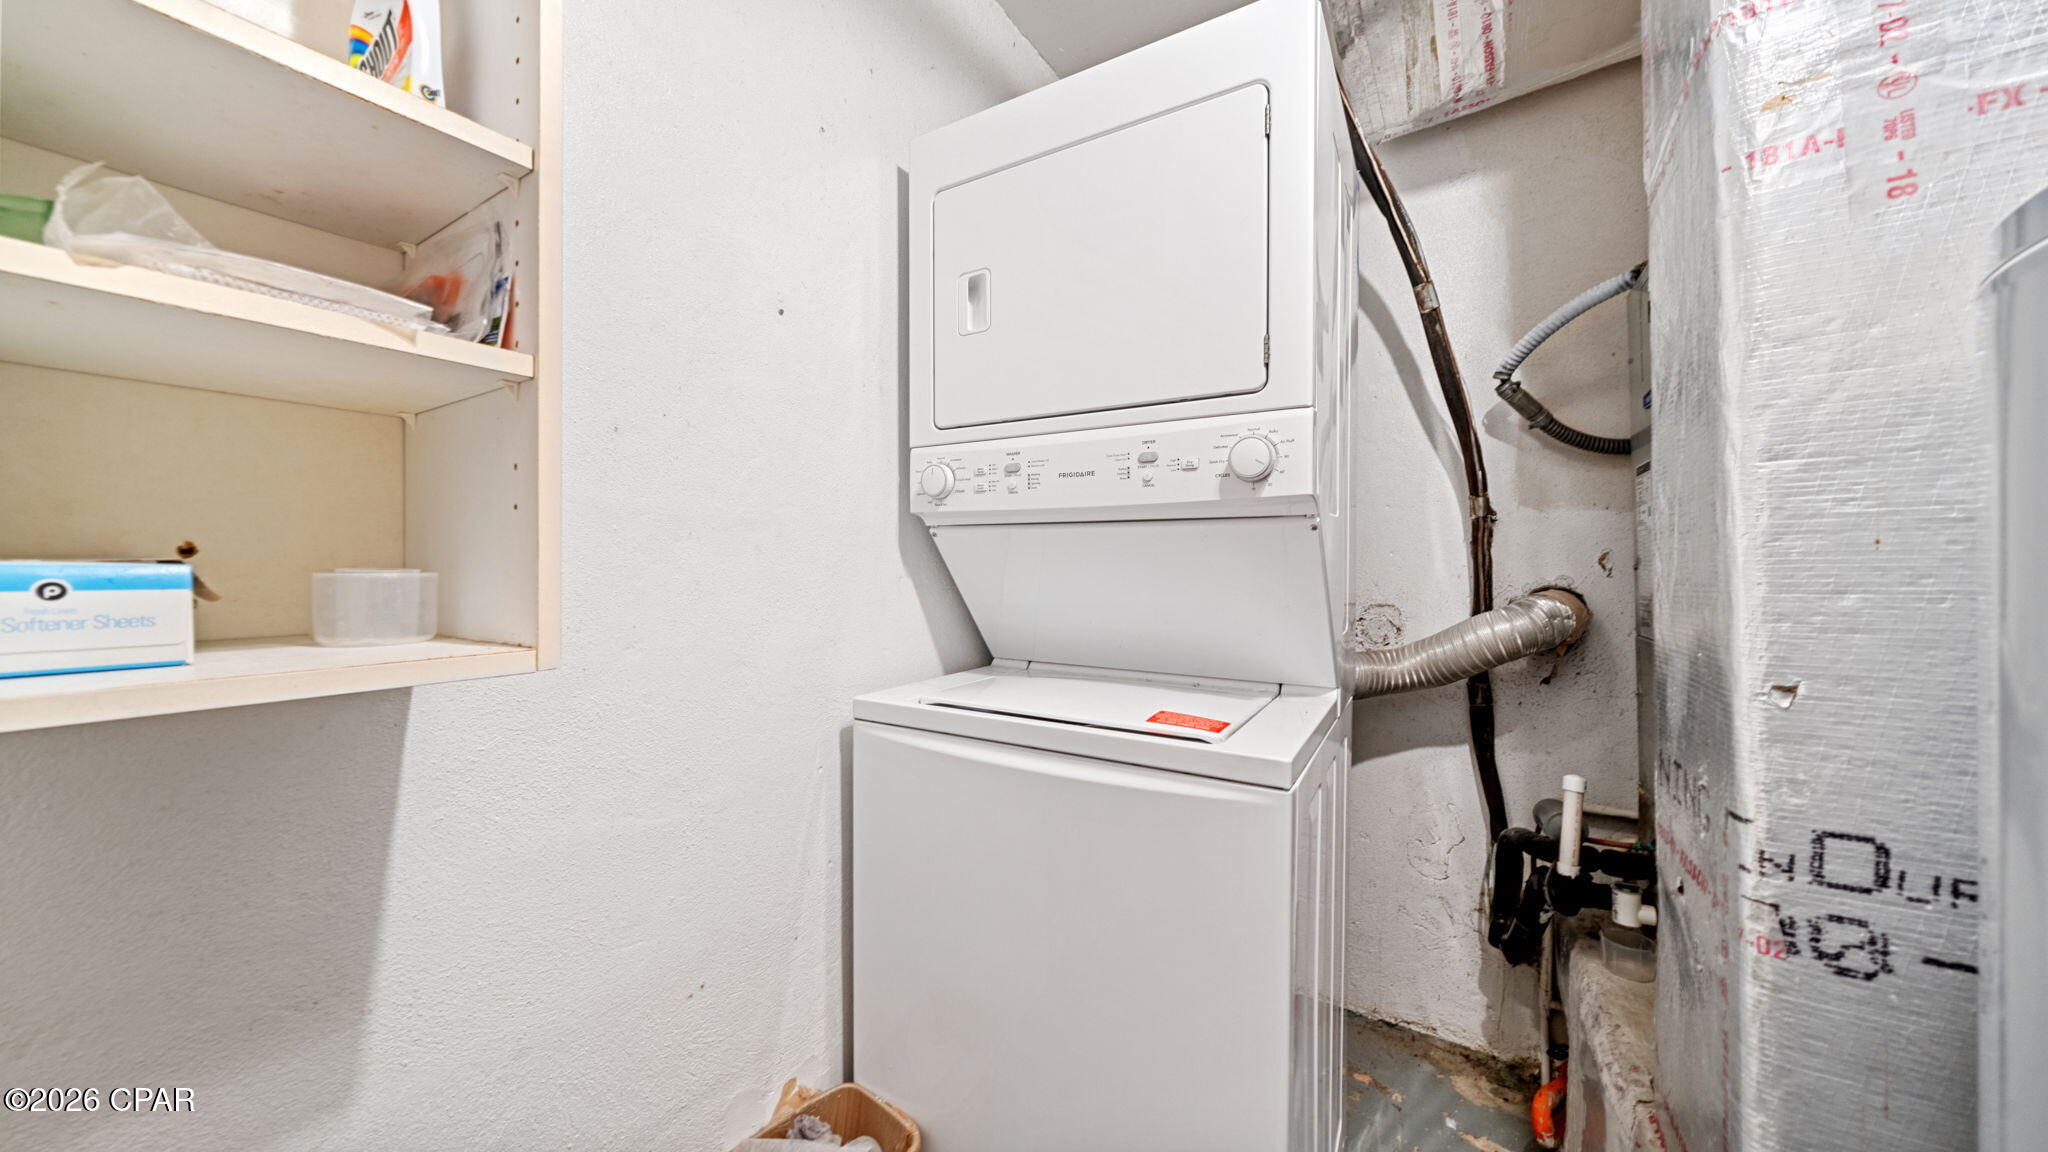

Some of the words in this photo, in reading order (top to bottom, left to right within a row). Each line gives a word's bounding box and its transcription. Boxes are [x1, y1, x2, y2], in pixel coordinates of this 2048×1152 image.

[1057, 470, 1096, 479] FRIGIDAIRE
[0, 616, 88, 633] Softener
[93, 614, 157, 630] Sheets
